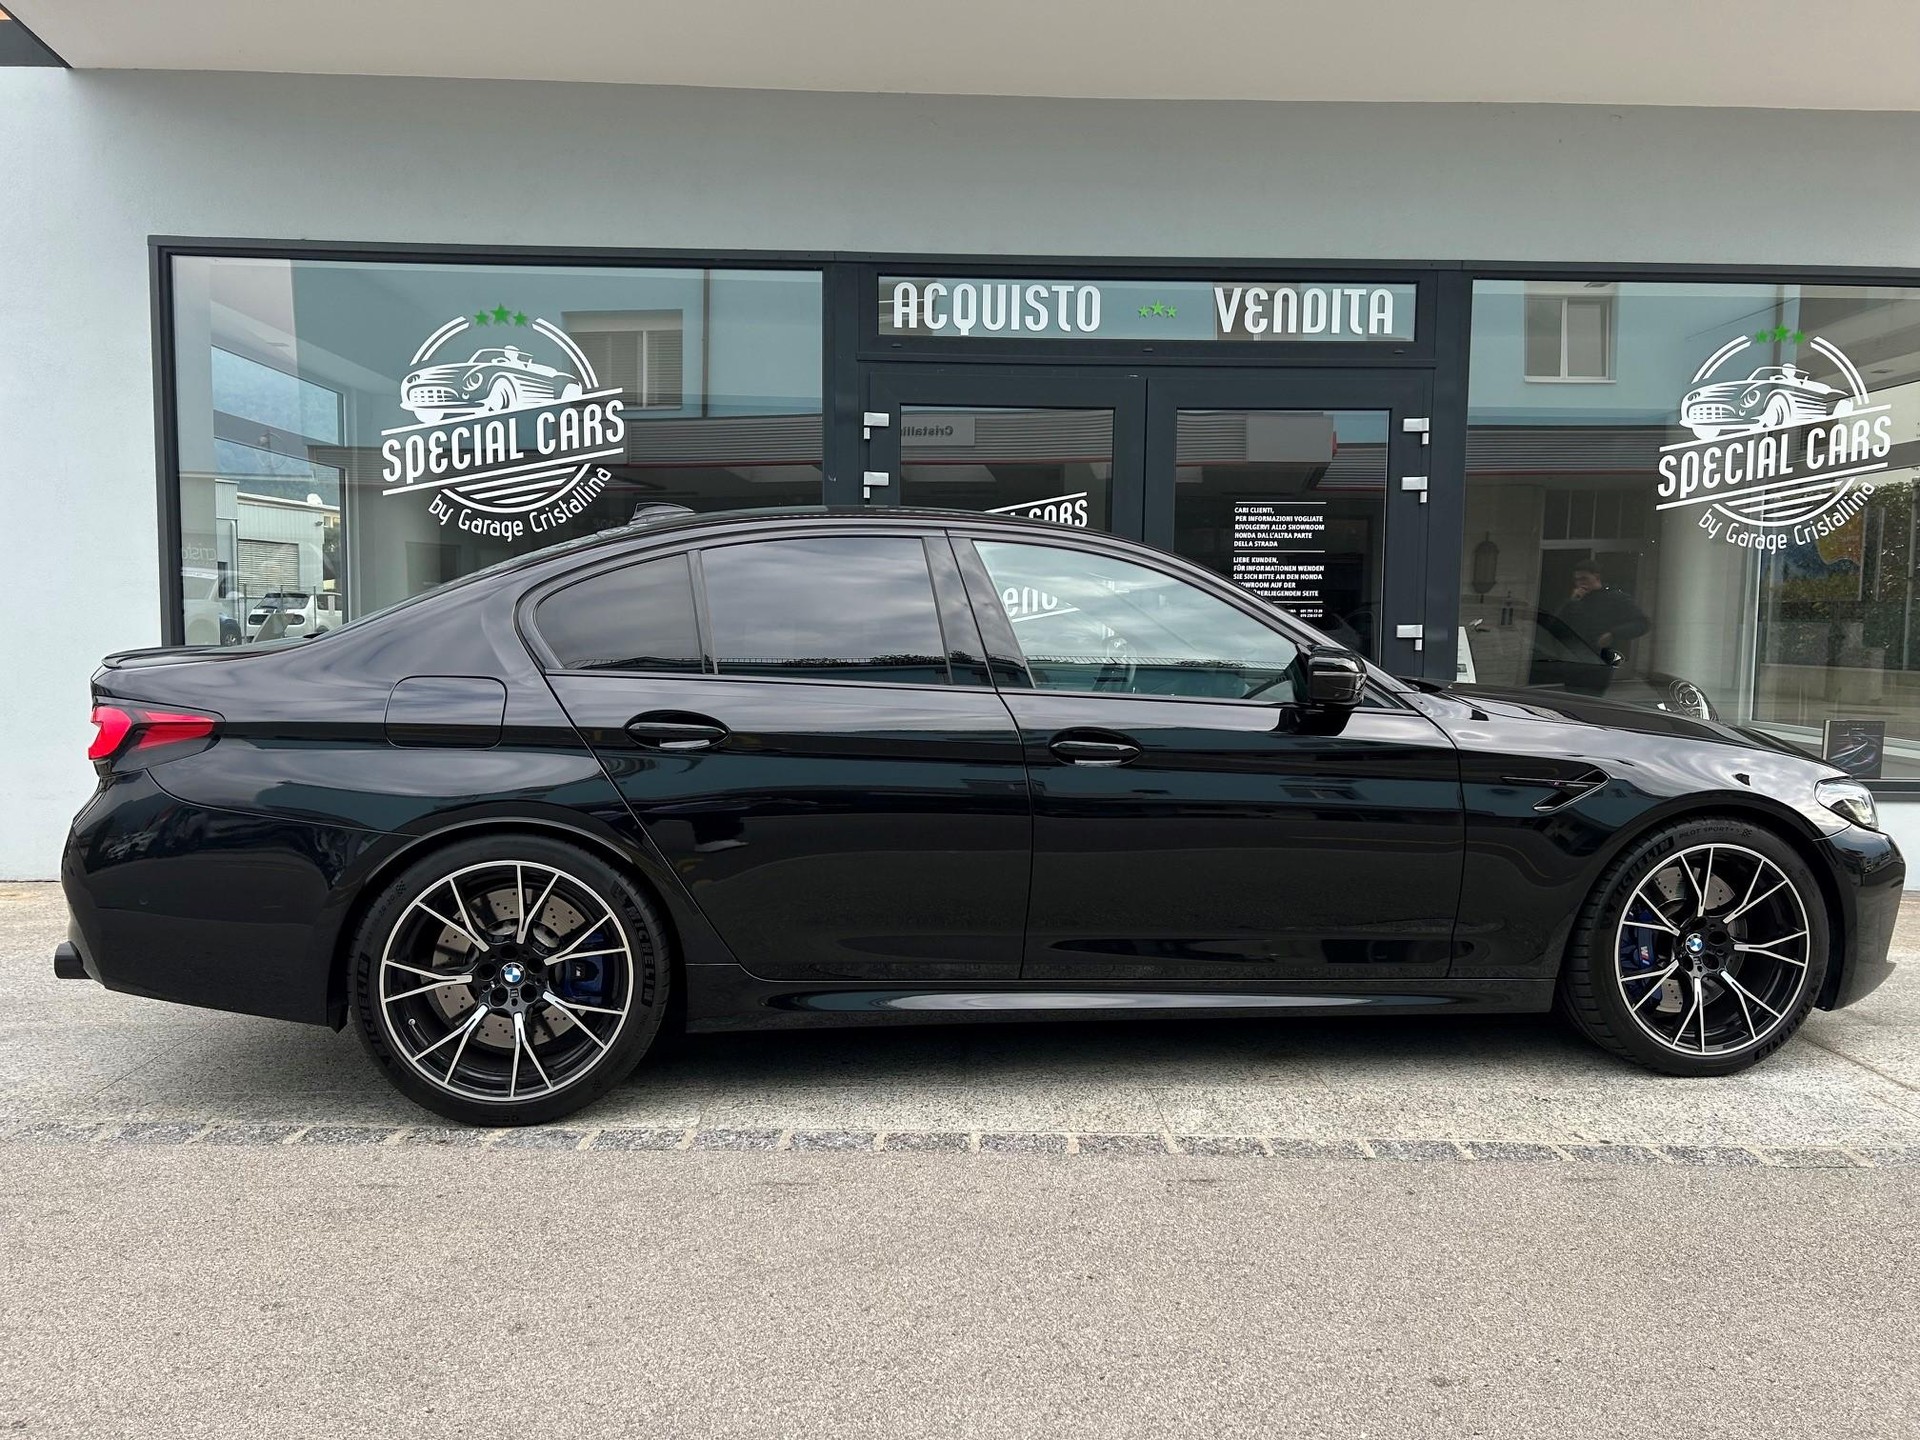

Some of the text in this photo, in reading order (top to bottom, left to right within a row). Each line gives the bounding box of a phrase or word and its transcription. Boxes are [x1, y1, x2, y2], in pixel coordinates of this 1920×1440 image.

[892, 282, 1394, 336] ACQUISTO VENDITA
[382, 399, 625, 484] SPECIAL CARS
[1657, 415, 1892, 499] SPECIAL CARS
[428, 494, 452, 526] by
[458, 509, 524, 542] Garage
[529, 467, 612, 533] Cristallina
[1698, 481, 1876, 555] by Garage Cristallina
[1233, 564, 1245, 572] FÜR
